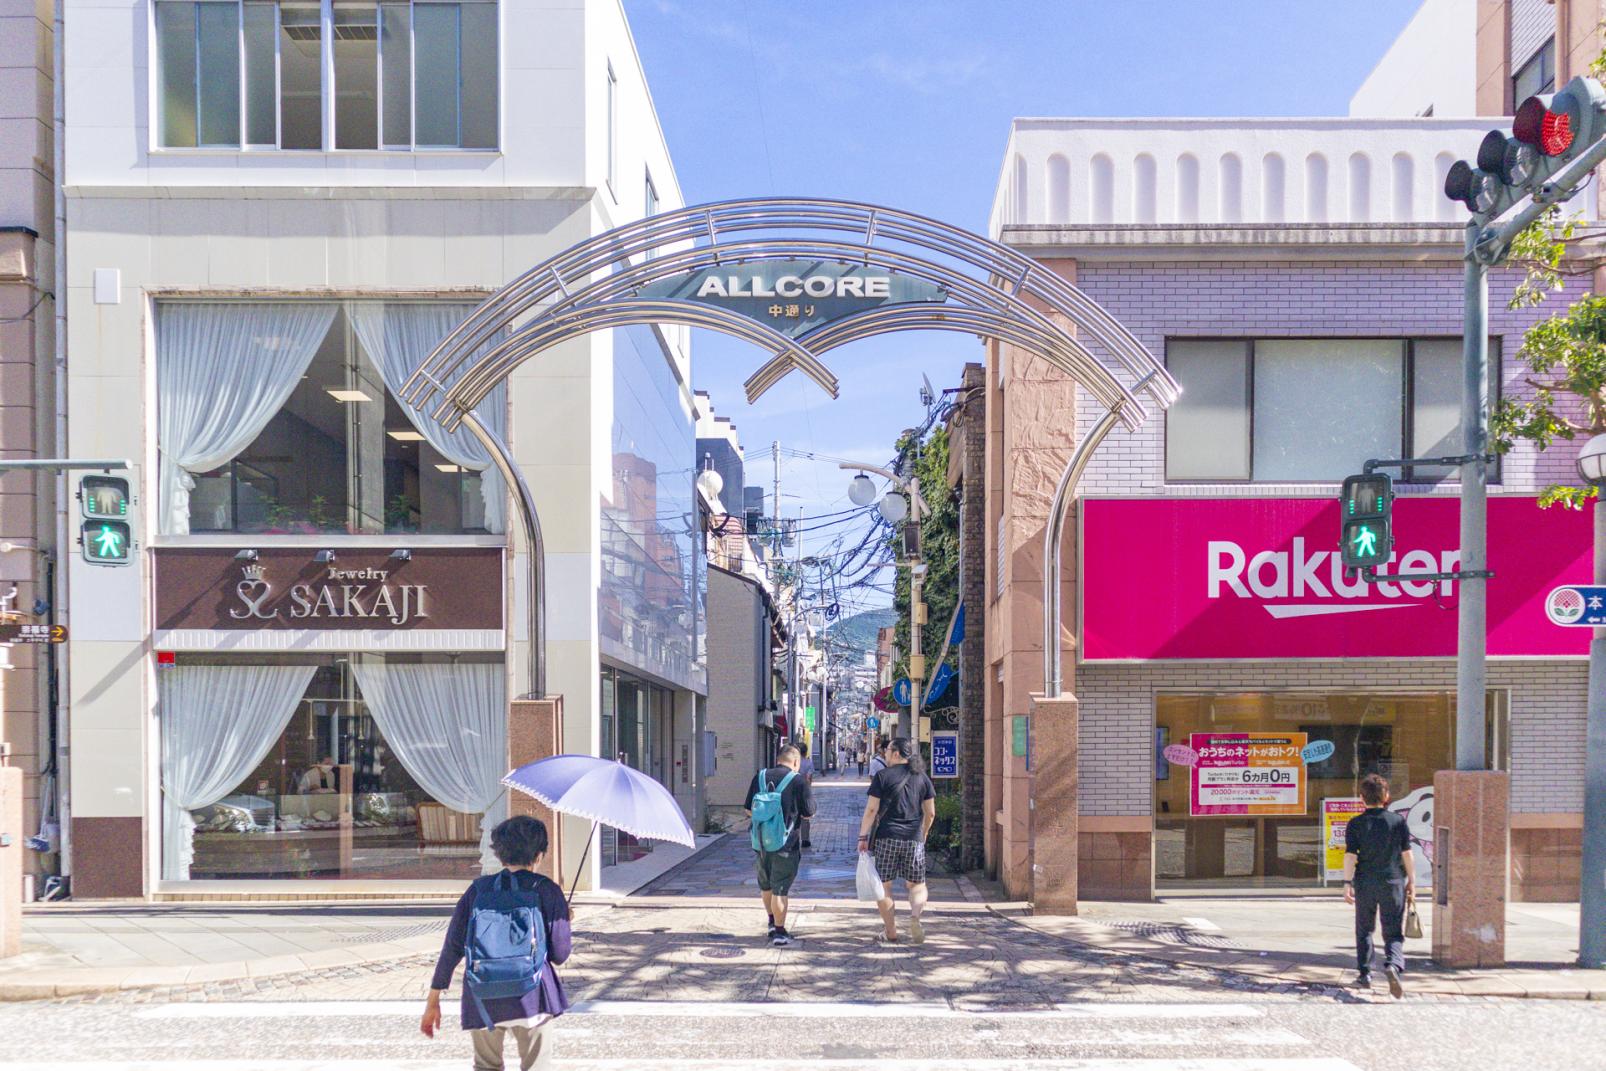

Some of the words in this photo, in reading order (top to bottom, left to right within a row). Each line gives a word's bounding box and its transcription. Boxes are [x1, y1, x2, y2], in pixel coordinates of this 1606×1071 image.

[697, 276, 890, 298] ALLCORE
[768, 304, 815, 318] 中通り
[327, 567, 388, 582] Jewelry
[290, 584, 429, 625] SAKAJI
[1242, 769, 1290, 783] 6カ月0円
